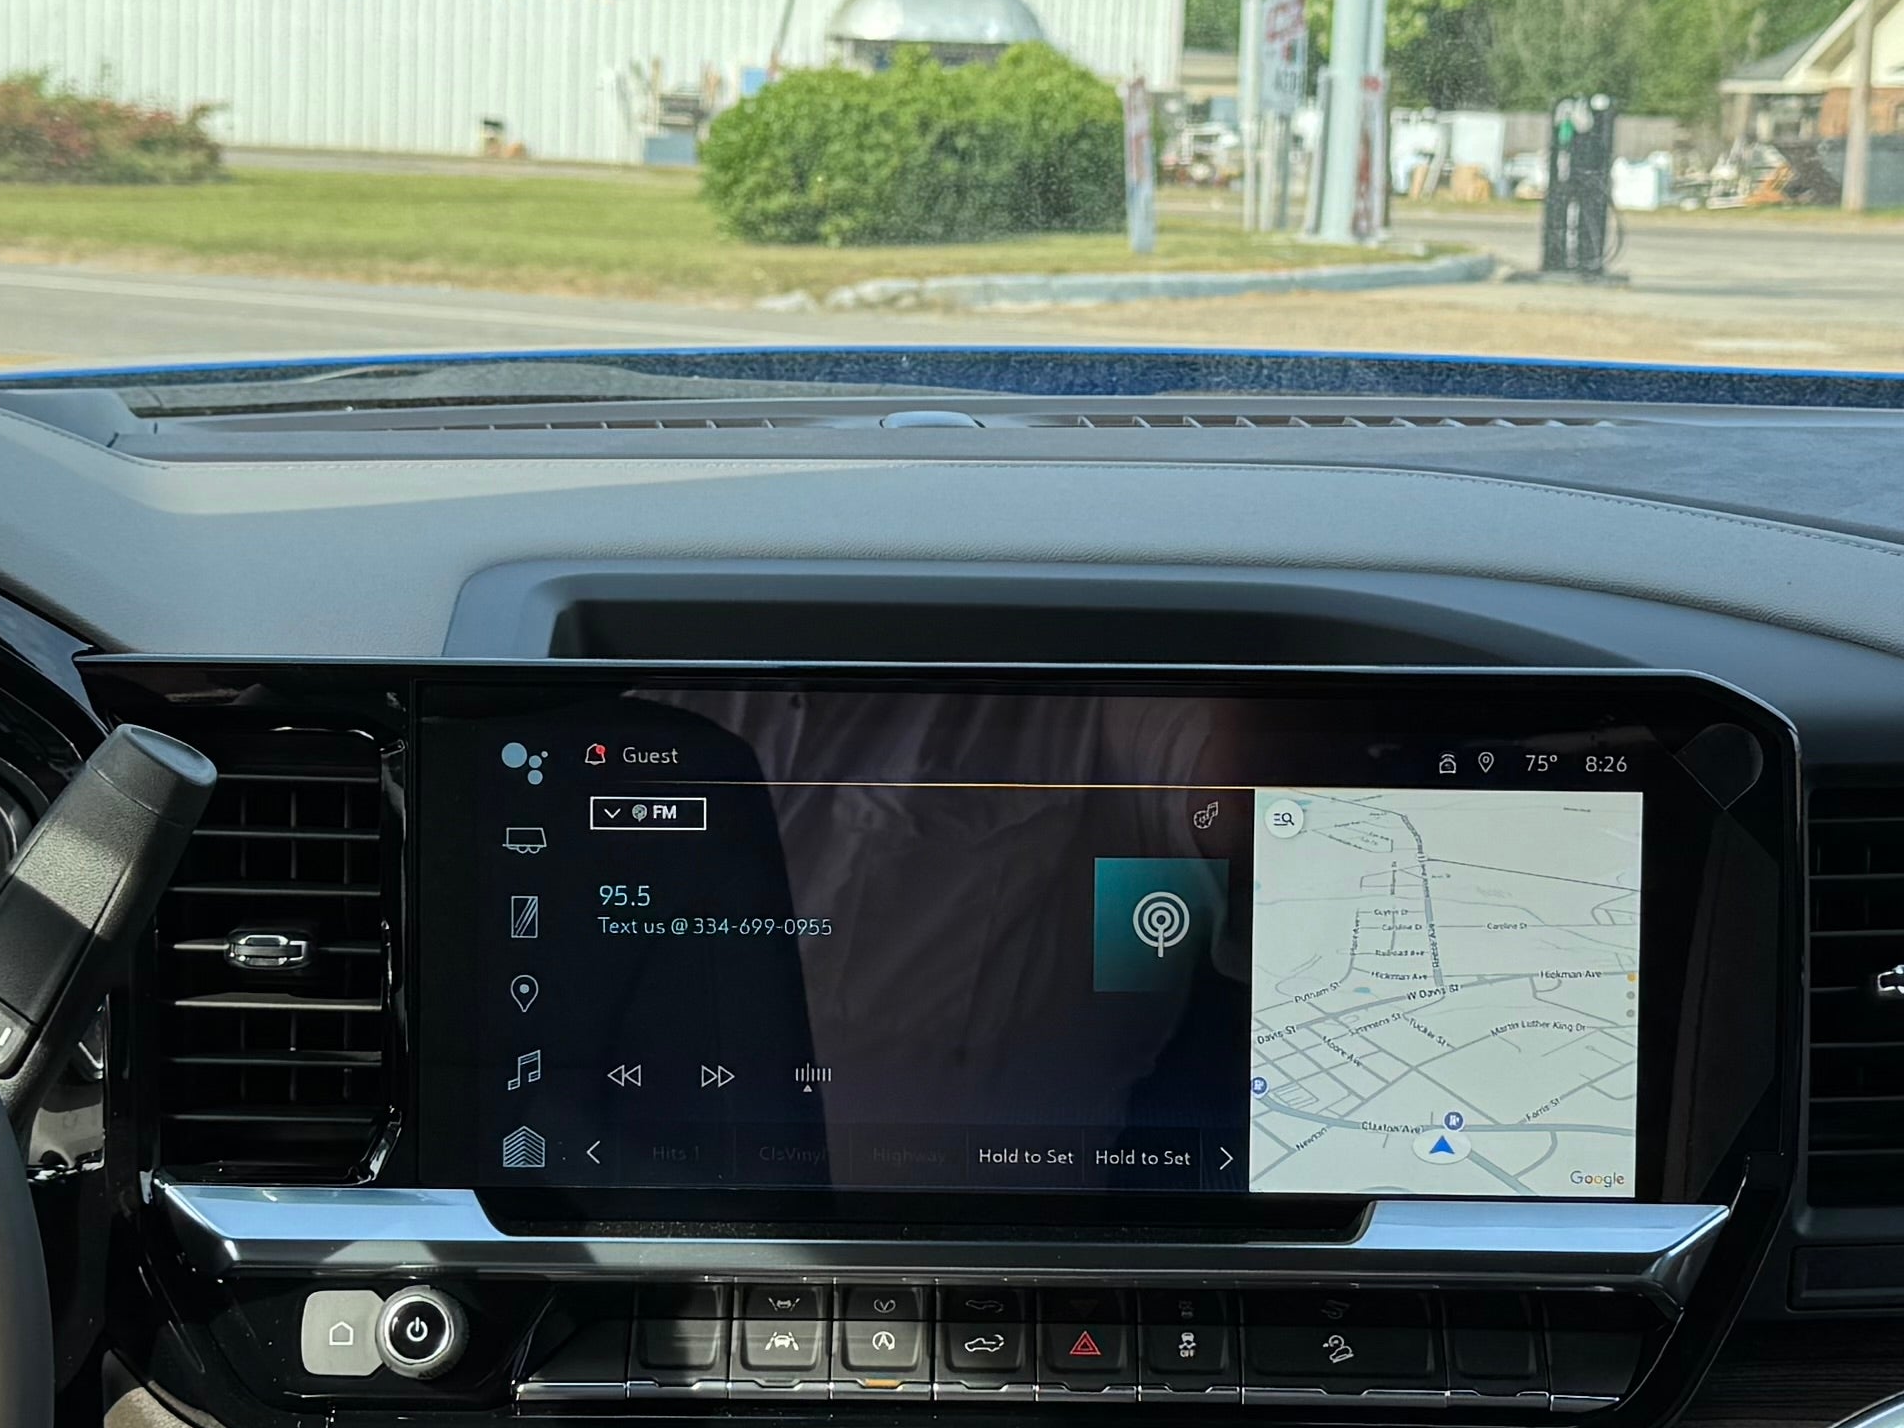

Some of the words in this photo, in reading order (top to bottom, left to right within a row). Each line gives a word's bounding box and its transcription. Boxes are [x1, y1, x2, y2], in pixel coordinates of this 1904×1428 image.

[622, 746, 680, 765] Guest
[1525, 754, 1559, 773] 75°
[1585, 755, 1628, 774] 8:26
[652, 804, 678, 820] FM
[599, 884, 652, 908] 95.5
[597, 916, 638, 935] Text
[643, 920, 666, 935] us
[670, 917, 689, 936] @
[692, 917, 833, 936] 334-699-0955
[978, 1148, 1019, 1164] Hold
[1024, 1149, 1042, 1164] to
[1046, 1148, 1076, 1164] Set
[1095, 1149, 1136, 1165] Hold
[1141, 1150, 1158, 1165] to
[1163, 1149, 1192, 1166] Set
[1569, 1170, 1626, 1188] Google
